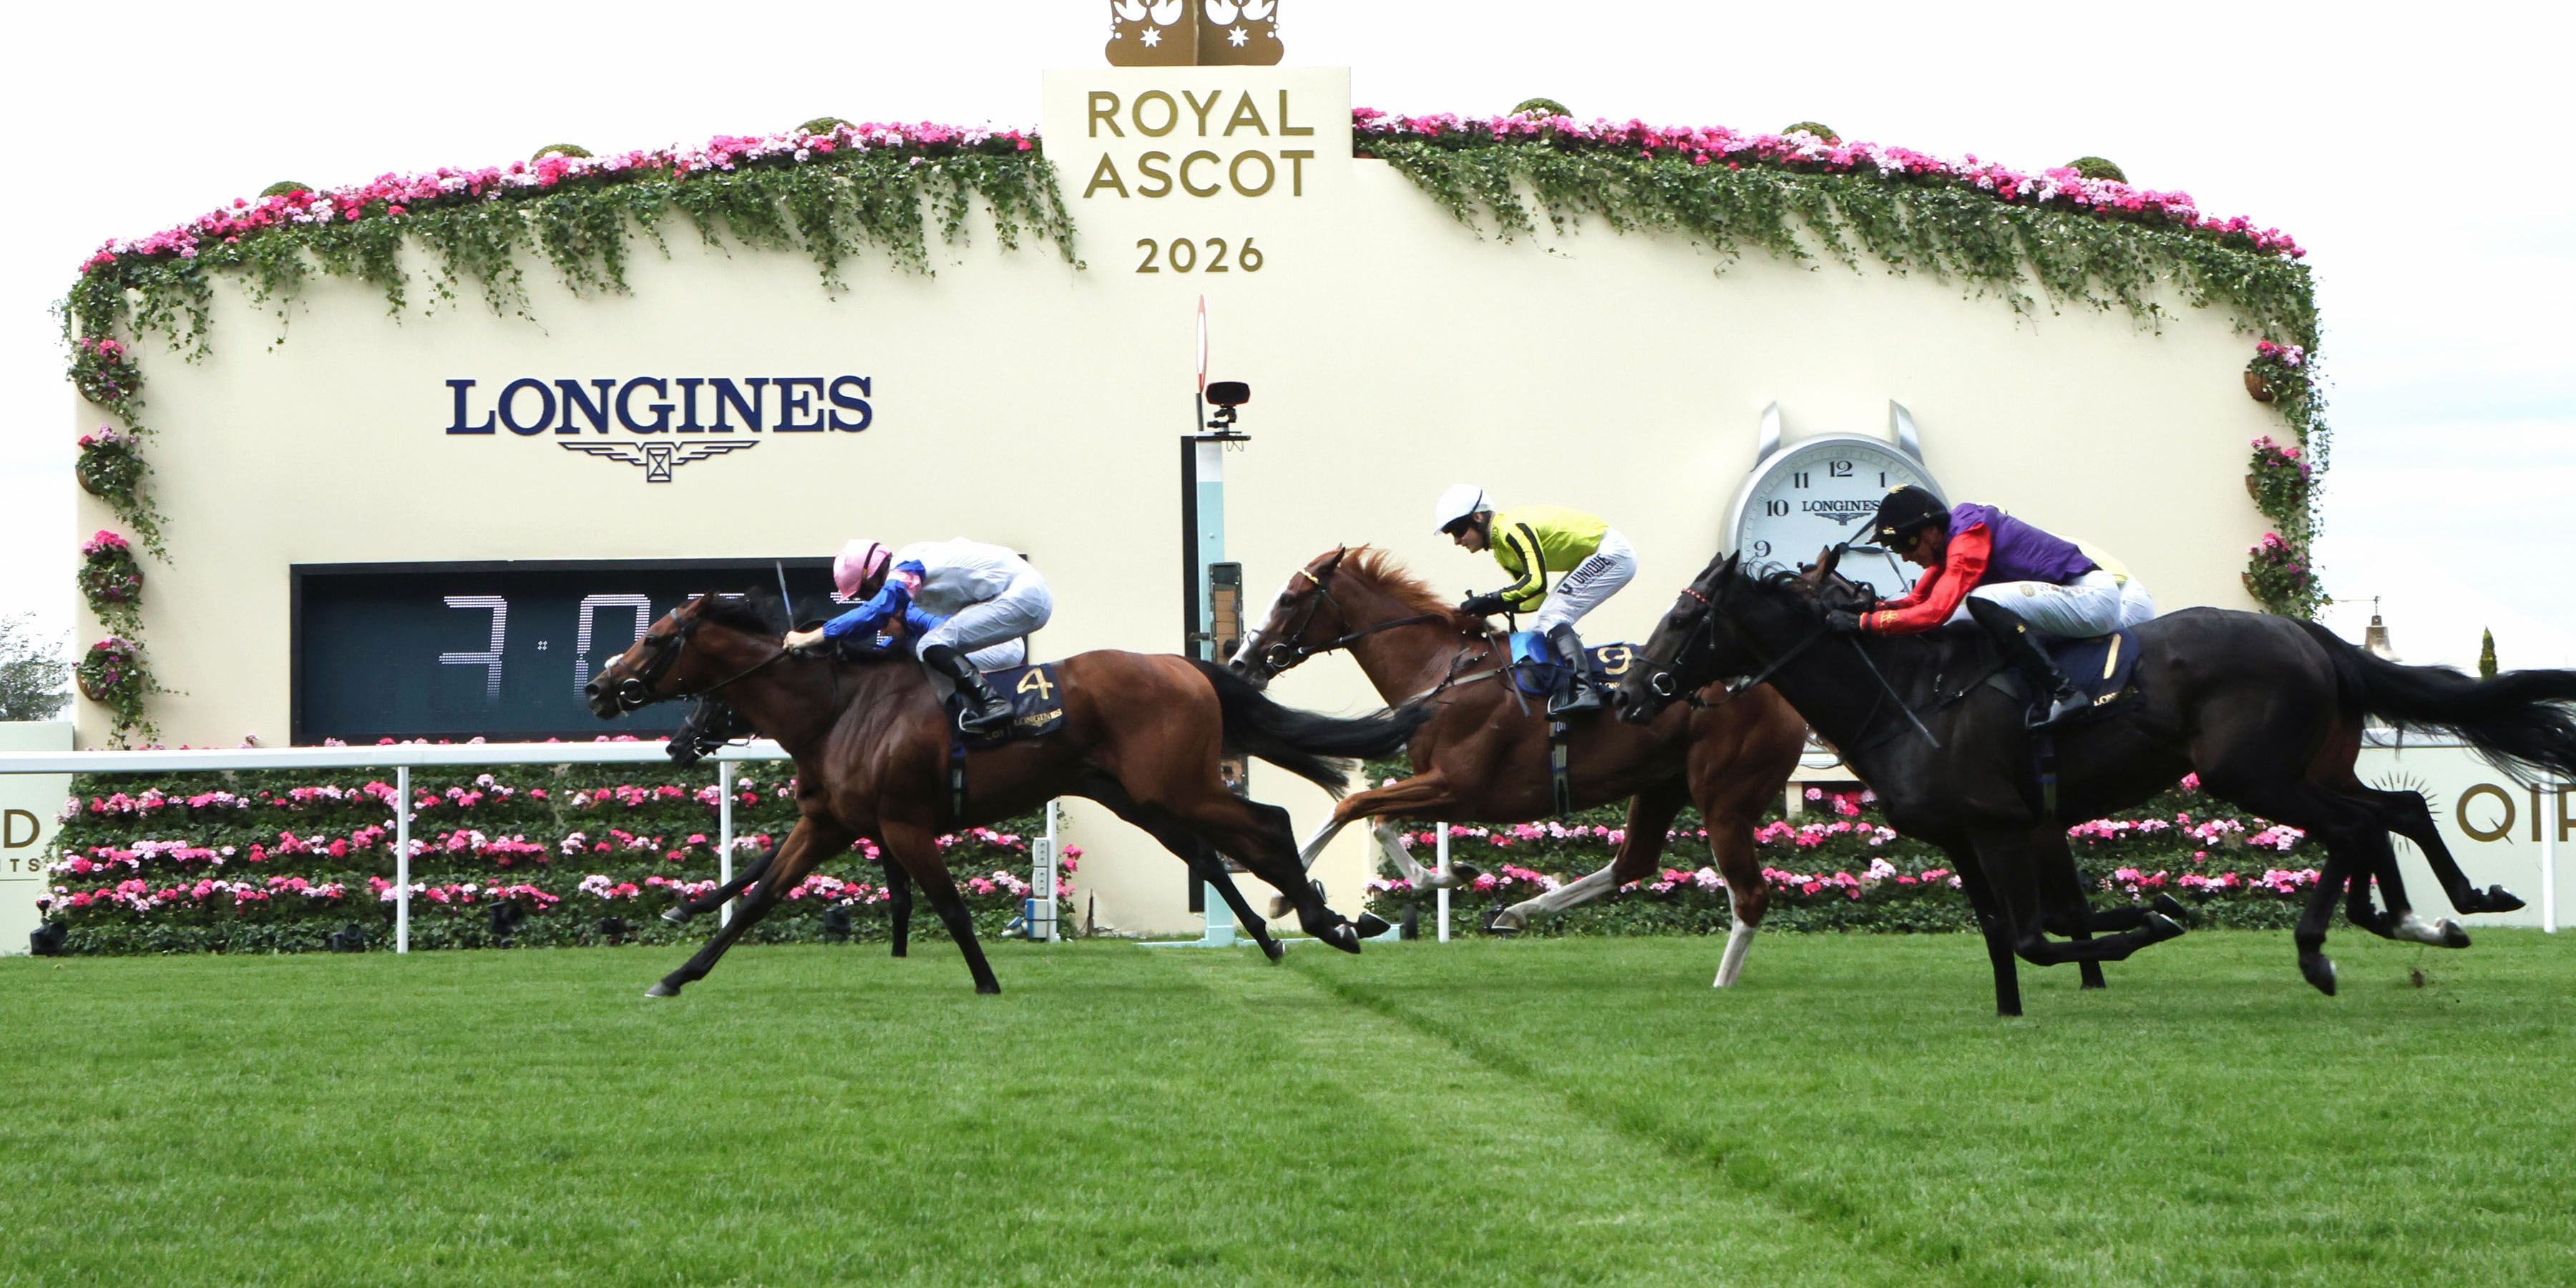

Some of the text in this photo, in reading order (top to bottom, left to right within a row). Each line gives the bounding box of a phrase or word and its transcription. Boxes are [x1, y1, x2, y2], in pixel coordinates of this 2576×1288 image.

[1088, 89, 1314, 137] ROYAL
[1082, 150, 1314, 199] ASCOT
[1135, 237, 1264, 273] 2026
[445, 375, 873, 435] LONGINES
[1829, 460, 1853, 477] 12
[1878, 471, 1886, 488] 1
[1793, 472, 1810, 489] 11
[1766, 499, 1789, 517] 10
[1802, 500, 1881, 512] LONGINES
[1754, 540, 1772, 557] 9
[1571, 553, 1611, 585] UNIQUE
[1596, 646, 1633, 675] 9
[1016, 667, 1054, 700] 4
[0, 857, 41, 872] TS
